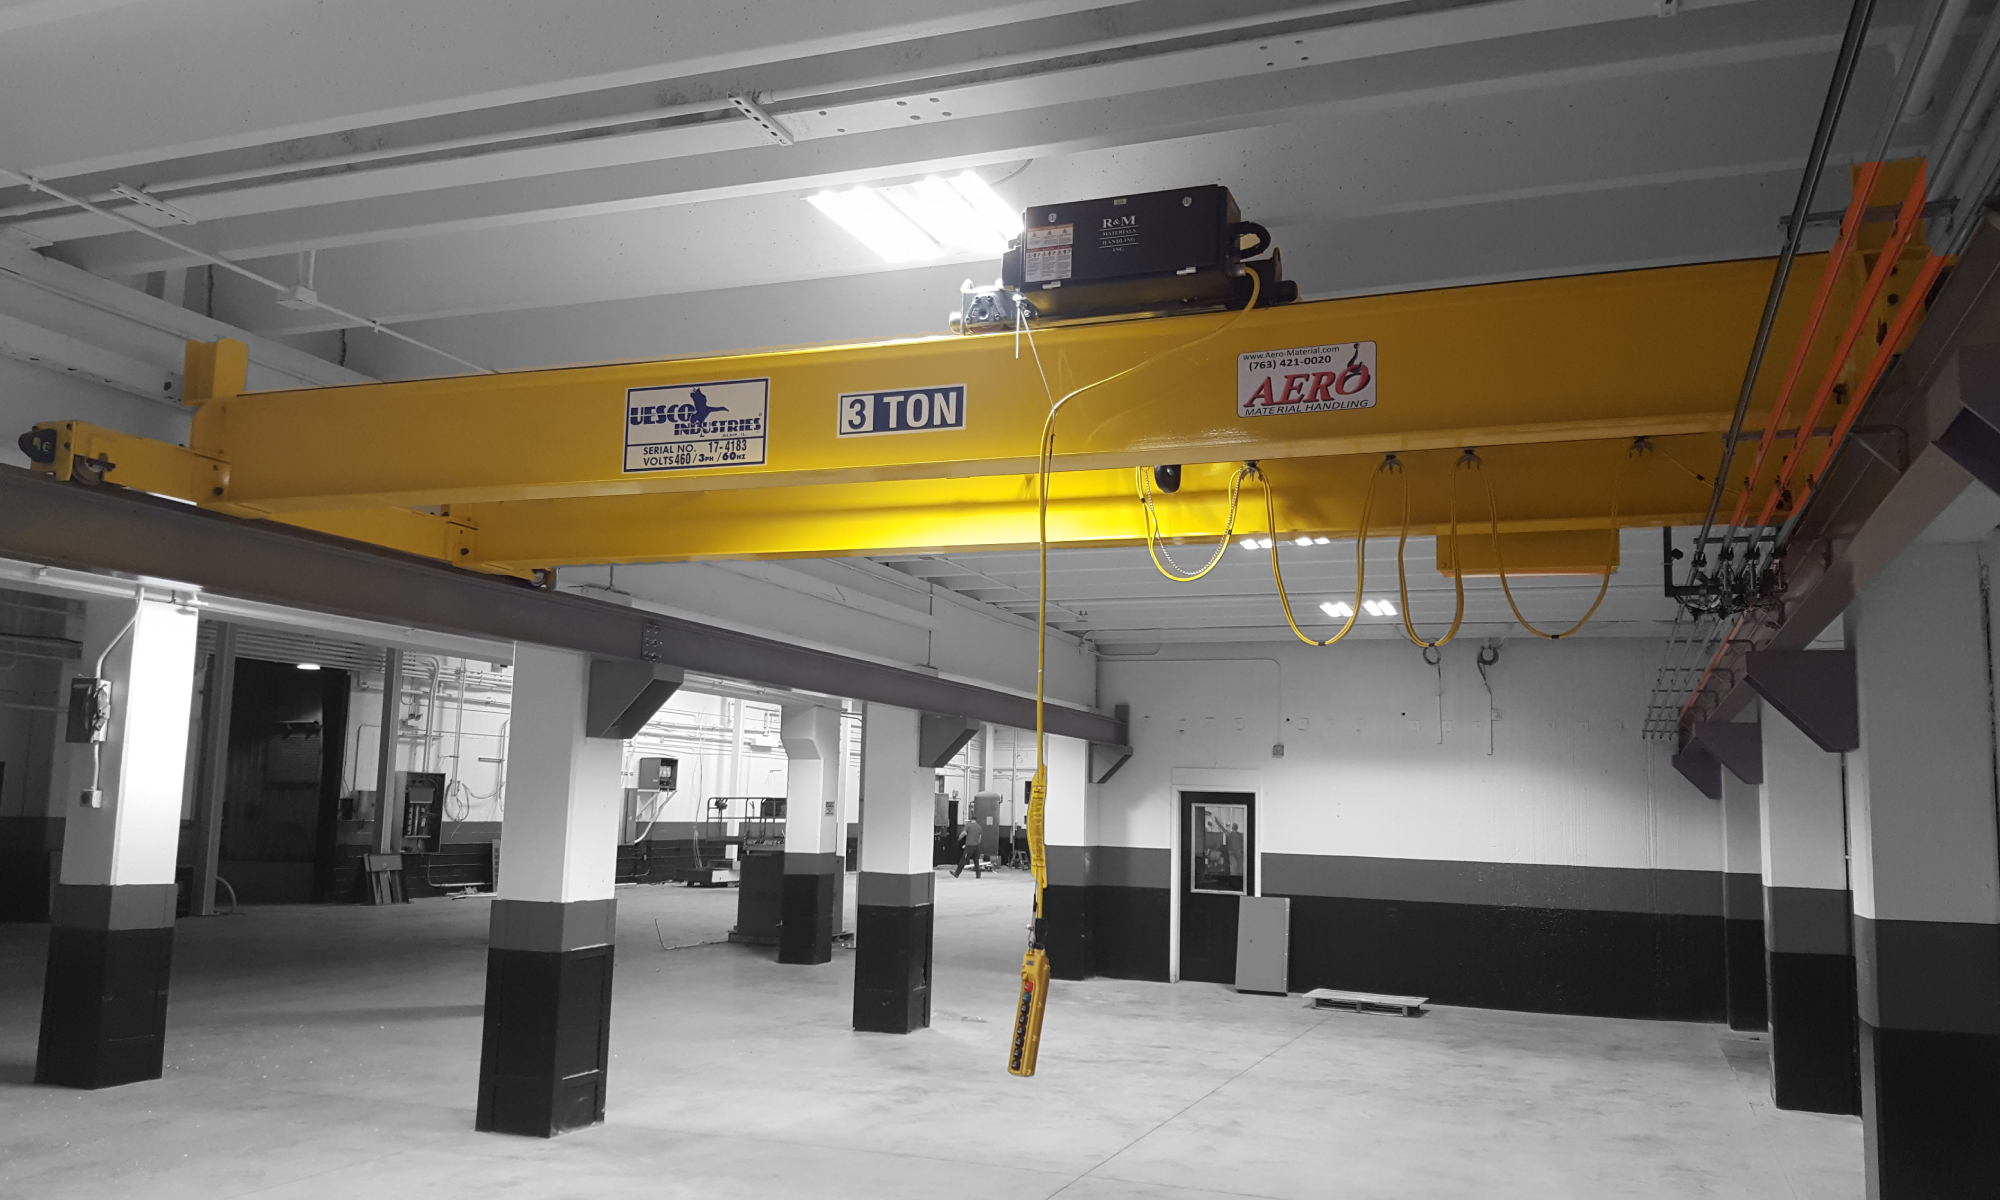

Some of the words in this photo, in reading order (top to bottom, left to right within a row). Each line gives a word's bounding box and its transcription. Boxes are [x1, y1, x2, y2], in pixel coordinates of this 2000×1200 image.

[1103, 215, 1136, 229] R&M
[1243, 345, 1340, 361] www.Aero-Material.com
[1249, 360, 1277, 372] (763)
[1279, 355, 1332, 368] 421-0020
[1243, 363, 1371, 408] AERO
[630, 403, 696, 426] UESCO
[847, 398, 867, 430] 3
[883, 391, 957, 429] TON
[1245, 405, 1301, 417] MATERIAL
[1305, 399, 1369, 412] HANDLING
[674, 417, 762, 436] INDUSTRIES
[643, 445, 674, 455] SERIAL
[677, 443, 697, 453] NO.
[708, 439, 747, 453] 17-4183
[643, 455, 674, 466] VOLTS
